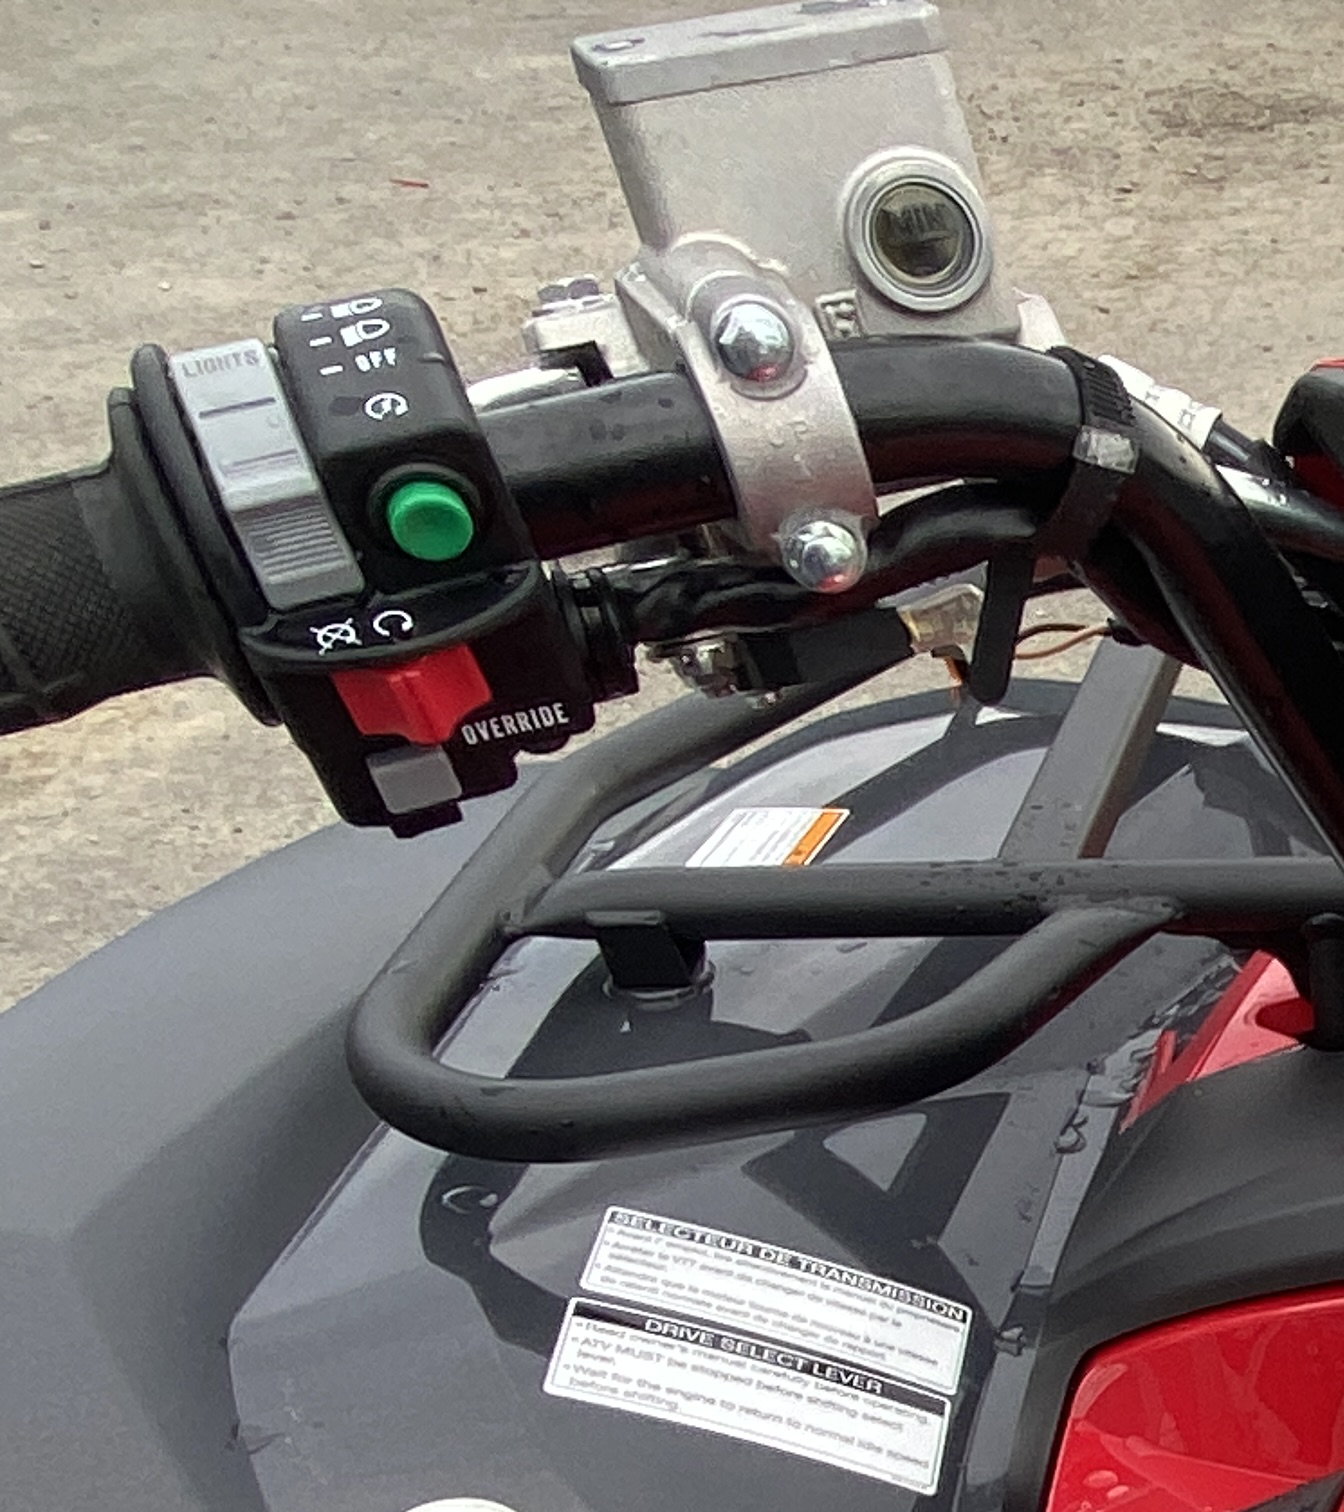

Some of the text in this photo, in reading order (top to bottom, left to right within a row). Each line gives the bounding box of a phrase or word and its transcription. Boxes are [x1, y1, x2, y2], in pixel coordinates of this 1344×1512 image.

[182, 349, 261, 378] LIGHTS
[355, 347, 396, 372] OFF
[461, 702, 569, 745] OVERRIDE
[759, 1243, 791, 1267] DE
[798, 1257, 966, 1322] TRANSMISSION
[644, 1317, 885, 1395] DRIVE SELECT LEVER
